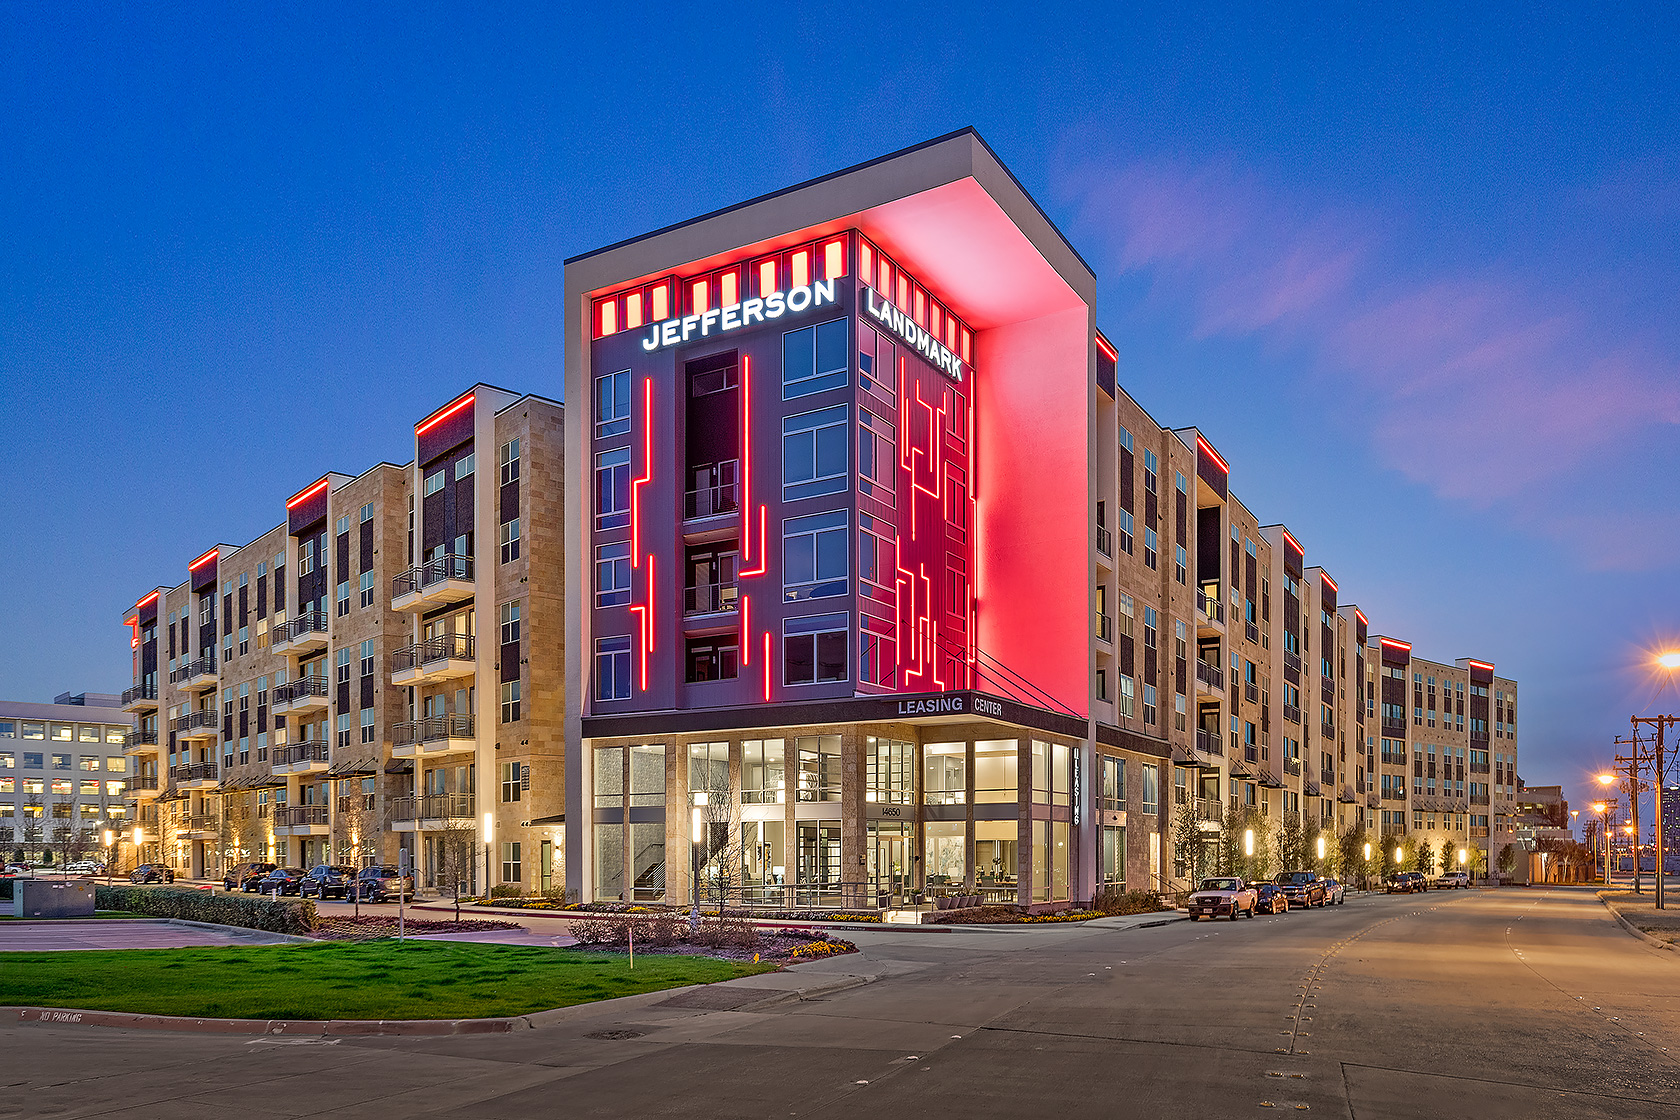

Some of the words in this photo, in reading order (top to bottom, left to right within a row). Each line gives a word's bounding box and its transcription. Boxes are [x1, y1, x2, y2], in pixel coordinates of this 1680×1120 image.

[642, 277, 835, 351] JEFFERSON
[868, 287, 962, 382] LANDMARK
[898, 698, 963, 714] LEASING
[974, 698, 1002, 716] CENTER
[882, 807, 901, 817] 14650
[40, 1011, 51, 1022] NO
[52, 1011, 82, 1023] PARKING
